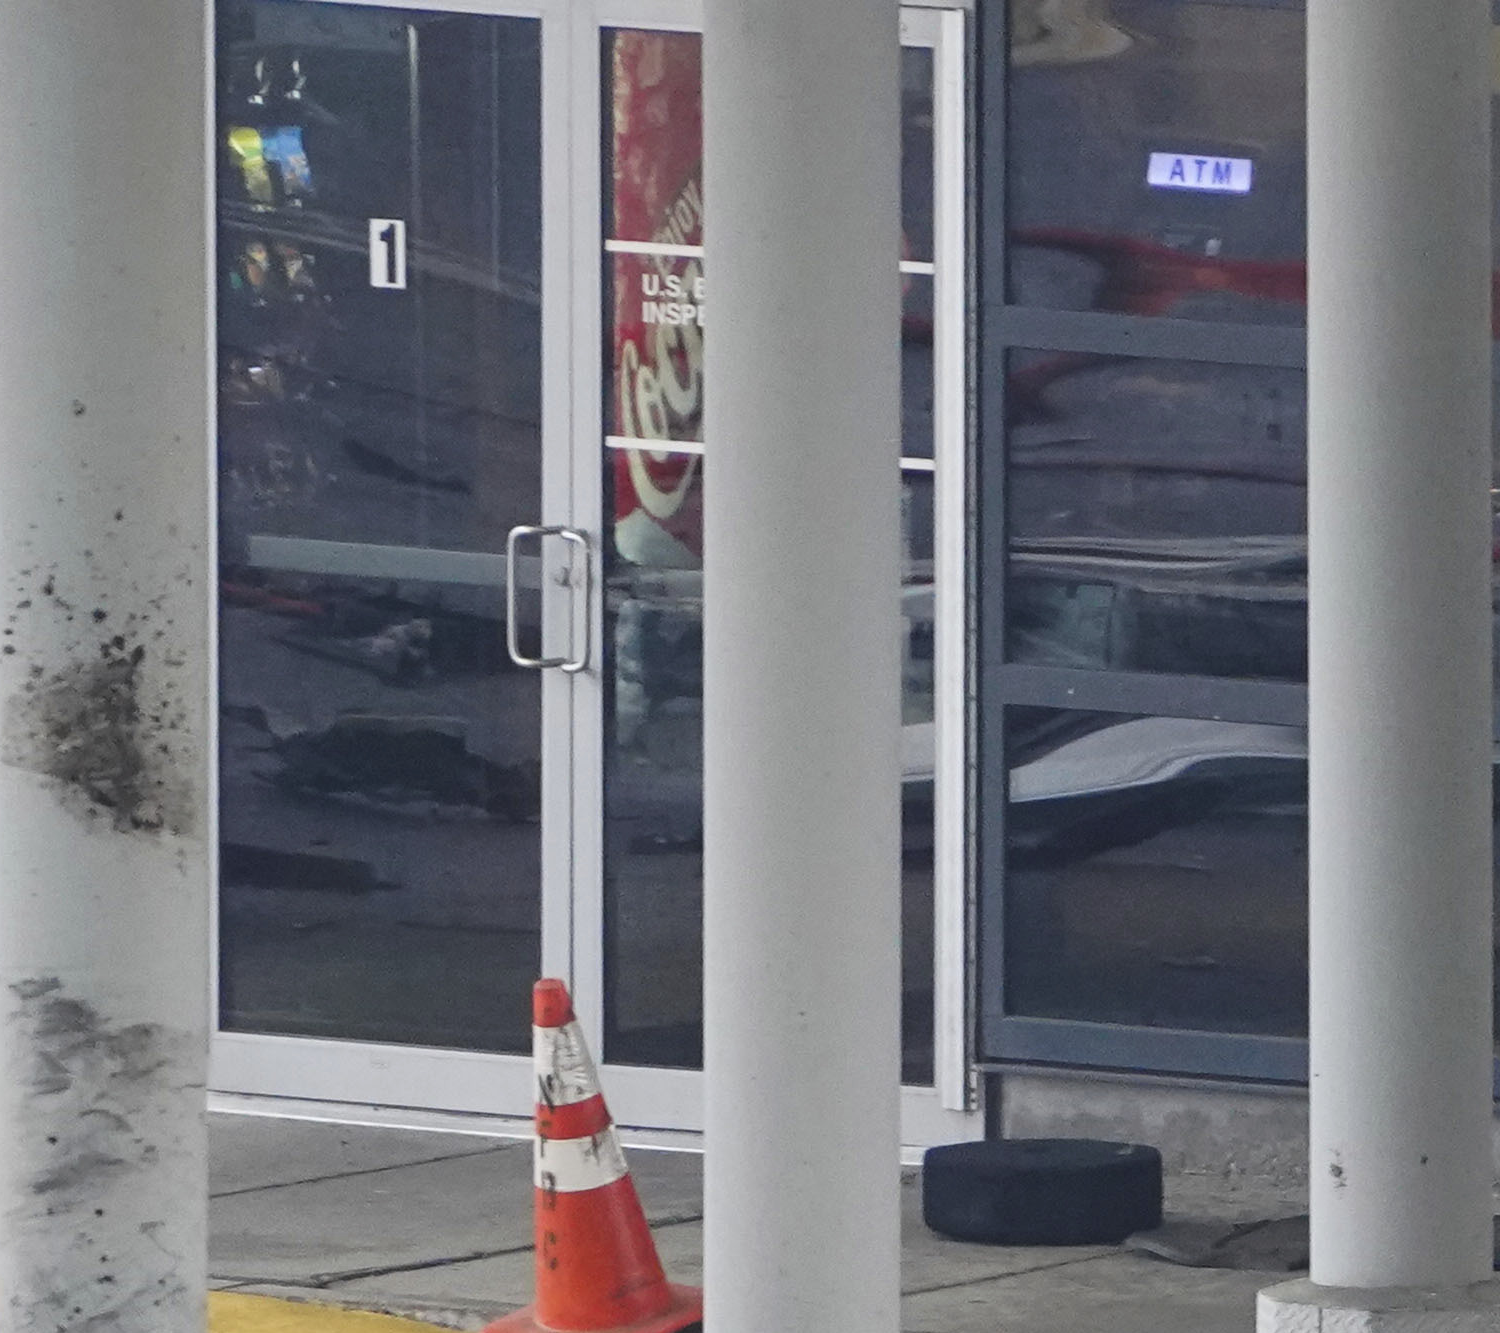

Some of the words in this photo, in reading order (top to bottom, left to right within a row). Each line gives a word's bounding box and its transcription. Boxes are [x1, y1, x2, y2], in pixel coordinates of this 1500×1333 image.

[1169, 158, 1233, 185] ATM
[380, 222, 396, 284] 1
[642, 273, 688, 298] U.S.
